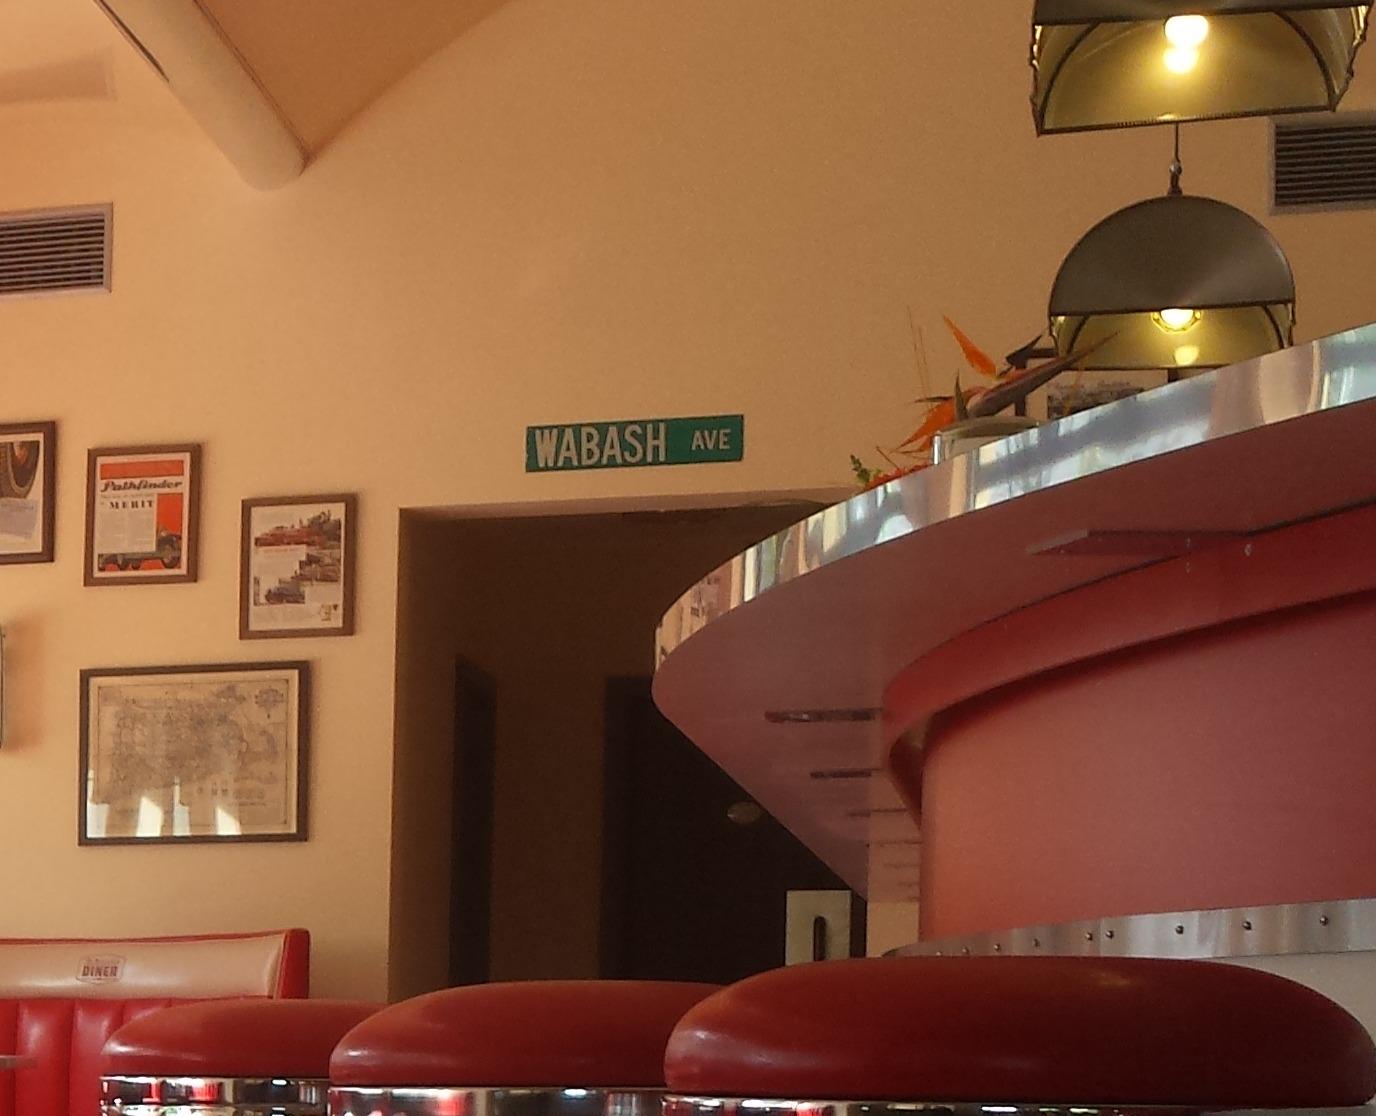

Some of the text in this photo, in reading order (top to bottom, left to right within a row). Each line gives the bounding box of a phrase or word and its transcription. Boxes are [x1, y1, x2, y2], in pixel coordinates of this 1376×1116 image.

[534, 421, 732, 468] WABASH AVE
[100, 479, 183, 493] Pathfinder
[82, 965, 119, 977] DINER
